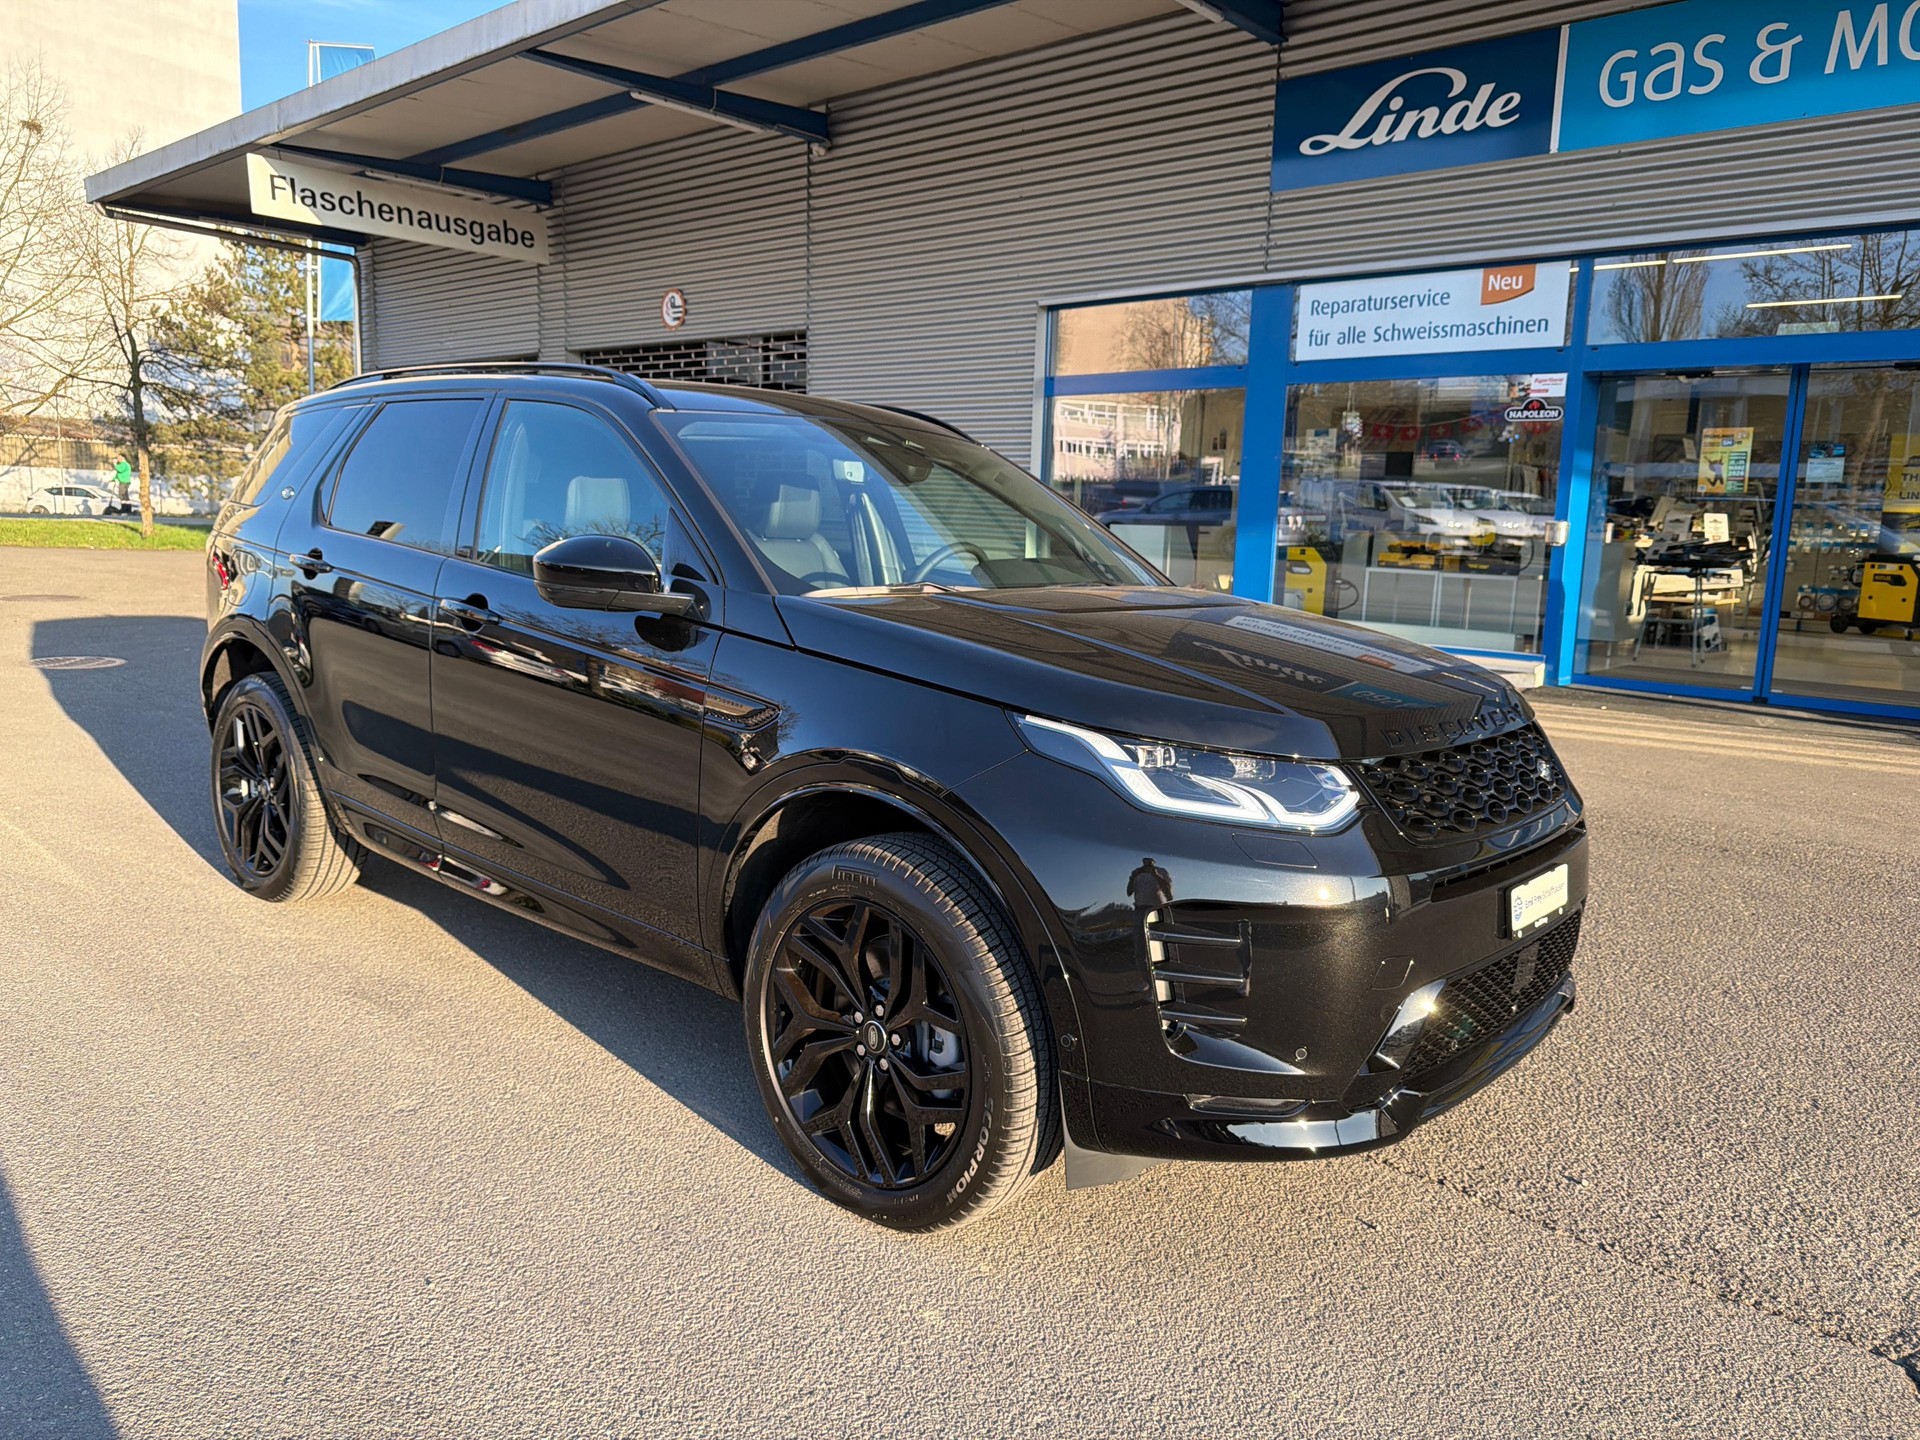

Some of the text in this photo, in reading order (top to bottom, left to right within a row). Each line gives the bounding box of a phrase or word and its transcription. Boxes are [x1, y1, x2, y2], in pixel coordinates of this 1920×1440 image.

[1749, 22, 1803, 84] &
[1299, 67, 1521, 155] Linde
[269, 174, 535, 248] Flaschenausgabe
[1488, 274, 1523, 291] Neu
[1310, 289, 1451, 319] Reparaturservice
[1308, 316, 1549, 347] für alle Schweissmaschinen
[1509, 410, 1559, 418] NAPOLEON
[1901, 473, 1920, 481] TH
[1381, 703, 1523, 748] DISCOVERY
[831, 865, 877, 887] PIRELLI
[946, 1098, 994, 1204] SCORPION
